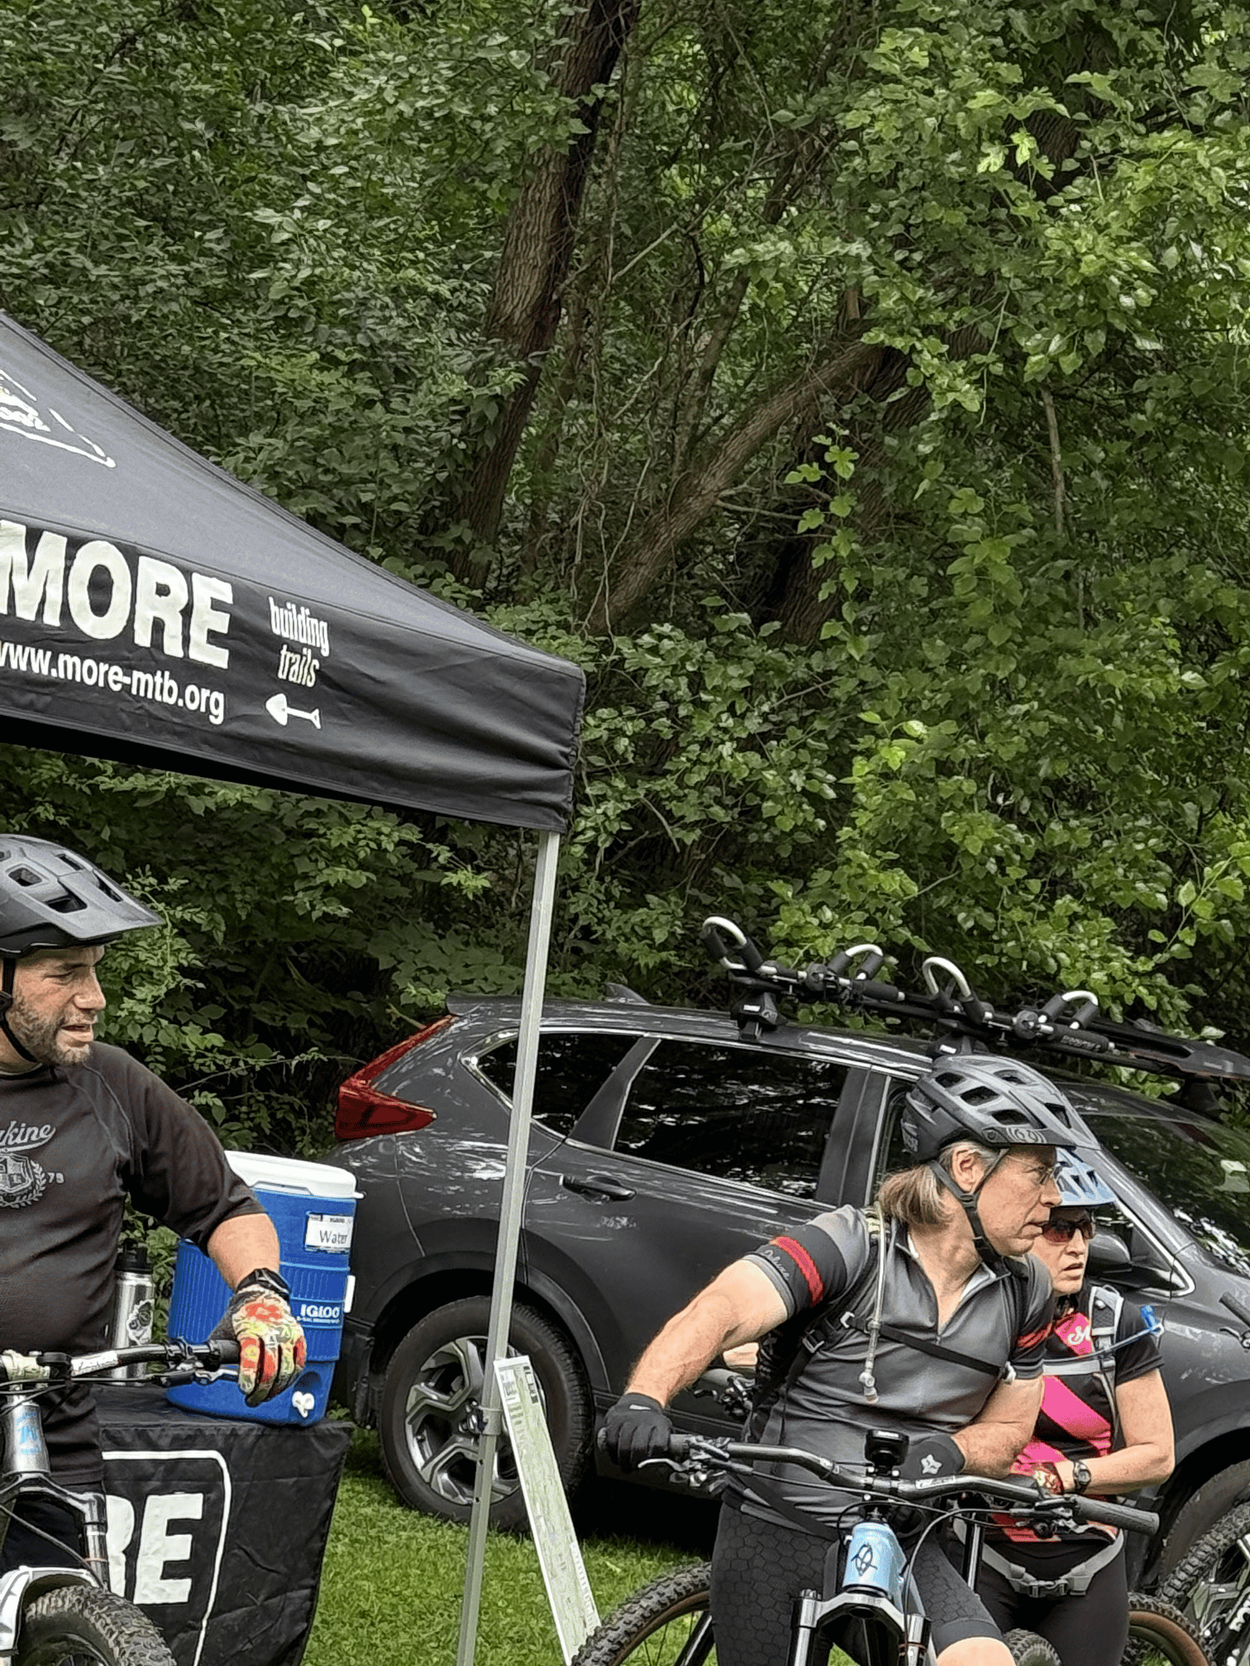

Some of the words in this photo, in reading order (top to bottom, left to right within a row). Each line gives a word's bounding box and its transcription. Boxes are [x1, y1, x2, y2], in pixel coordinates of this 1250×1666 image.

[0, 519, 233, 669] MORE
[269, 596, 330, 657] building
[277, 645, 320, 688] trails
[319, 1229, 348, 1245] Water
[300, 1303, 341, 1319] IGLOO
